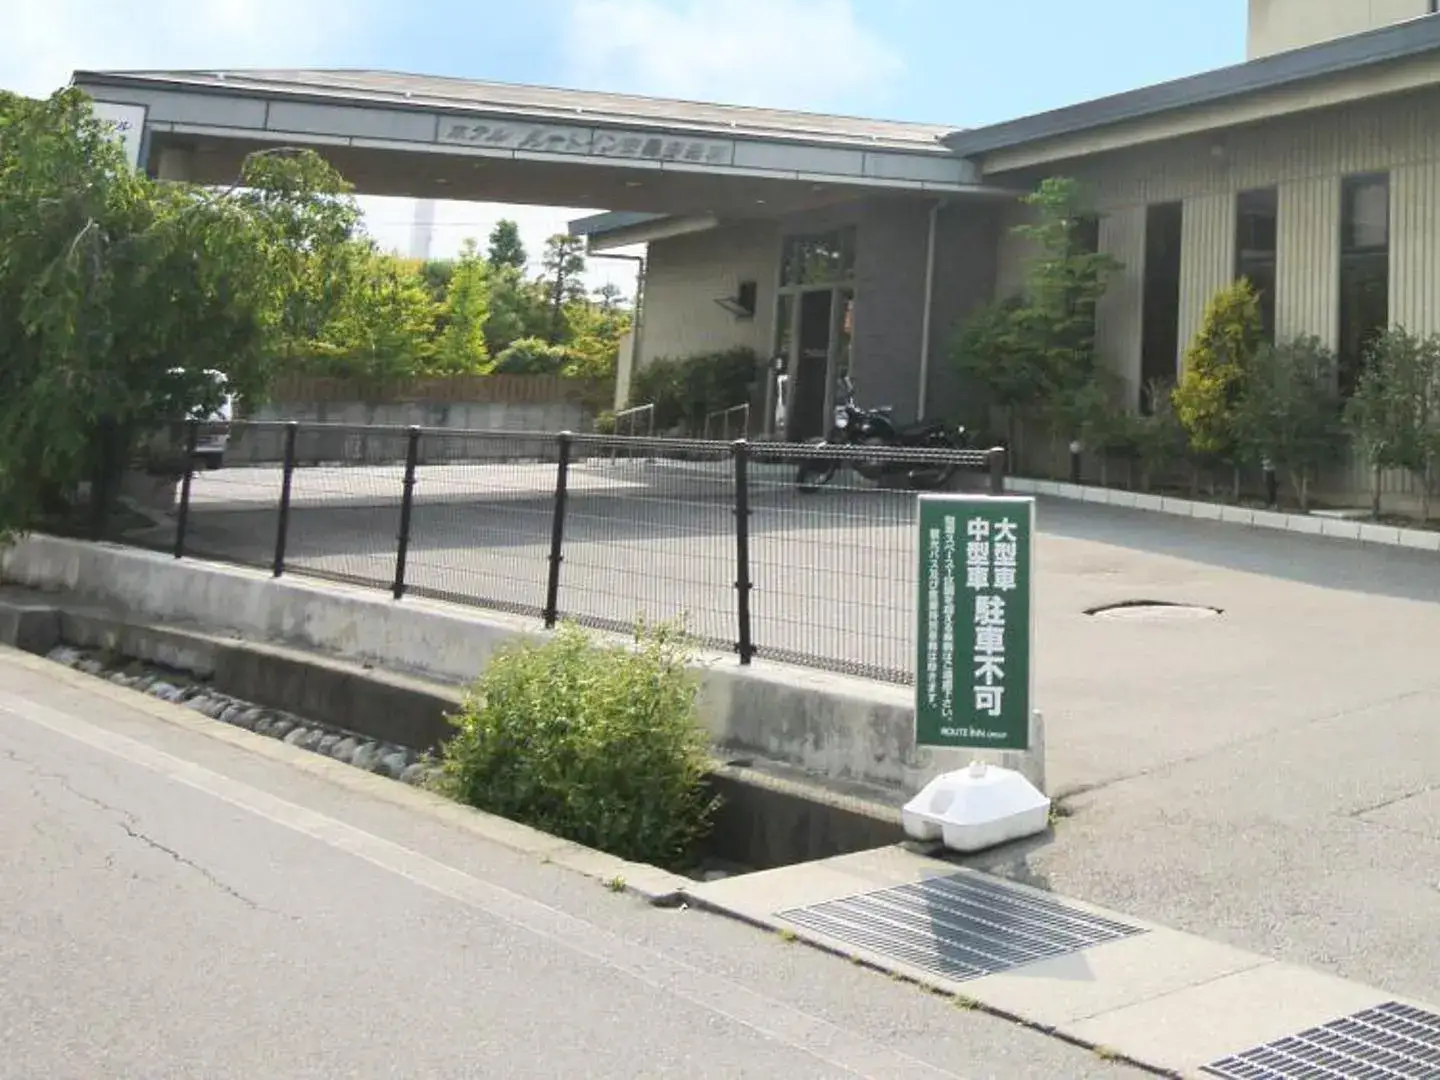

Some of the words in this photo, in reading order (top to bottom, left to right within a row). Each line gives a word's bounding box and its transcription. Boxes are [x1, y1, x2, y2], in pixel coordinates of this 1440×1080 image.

[966, 517, 990, 591] 中型車
[993, 517, 1017, 591] 大型車
[973, 595, 1005, 716] 駐車不可
[940, 727, 968, 738] ROUTE
